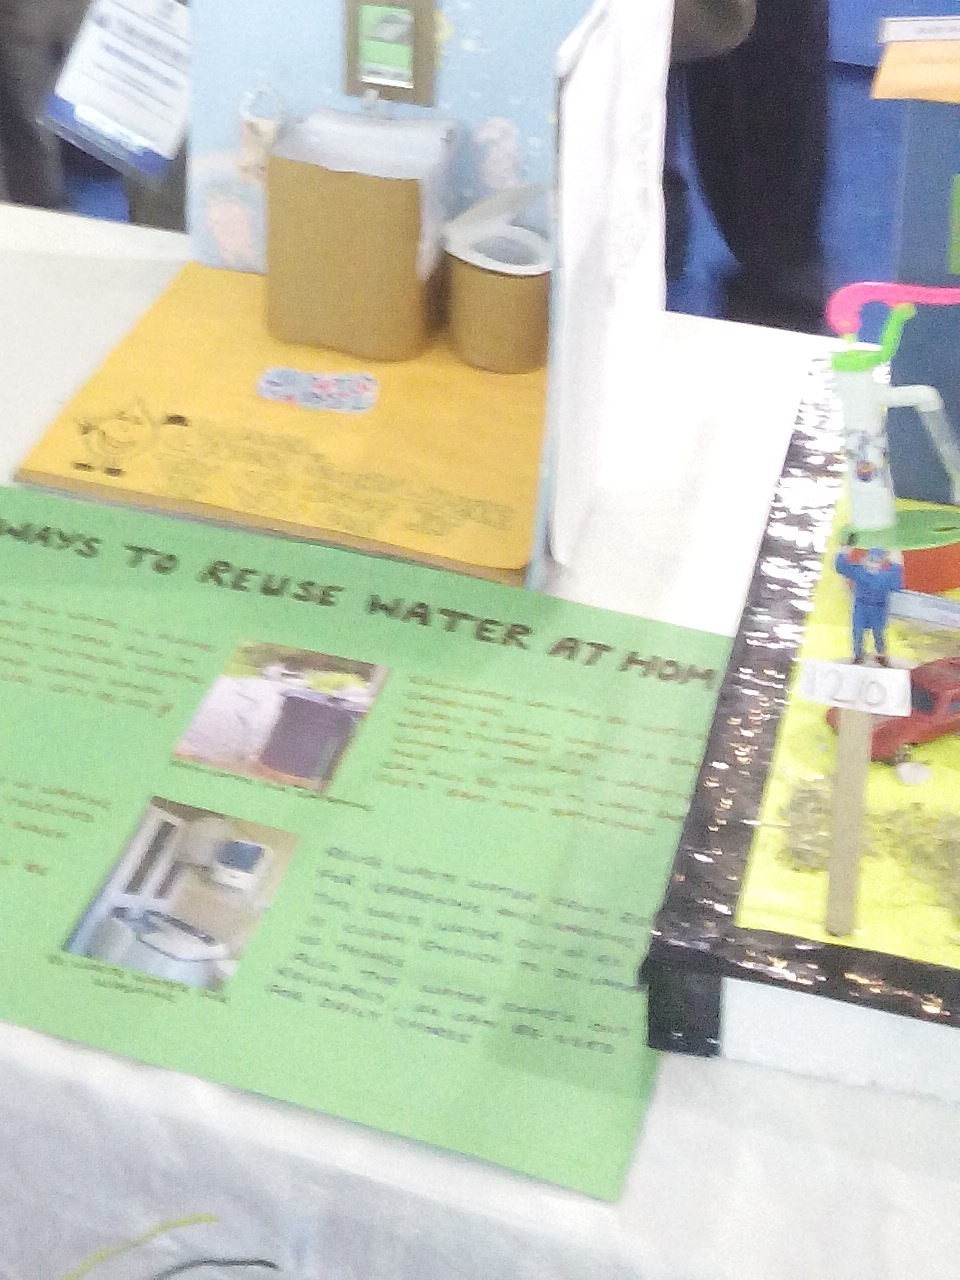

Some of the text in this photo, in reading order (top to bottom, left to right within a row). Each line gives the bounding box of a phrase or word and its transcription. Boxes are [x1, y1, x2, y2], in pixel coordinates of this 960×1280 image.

[124, 543, 180, 576] TO
[198, 559, 345, 608] REUSE
[366, 593, 535, 650] WATER
[548, 636, 614, 667] AT
